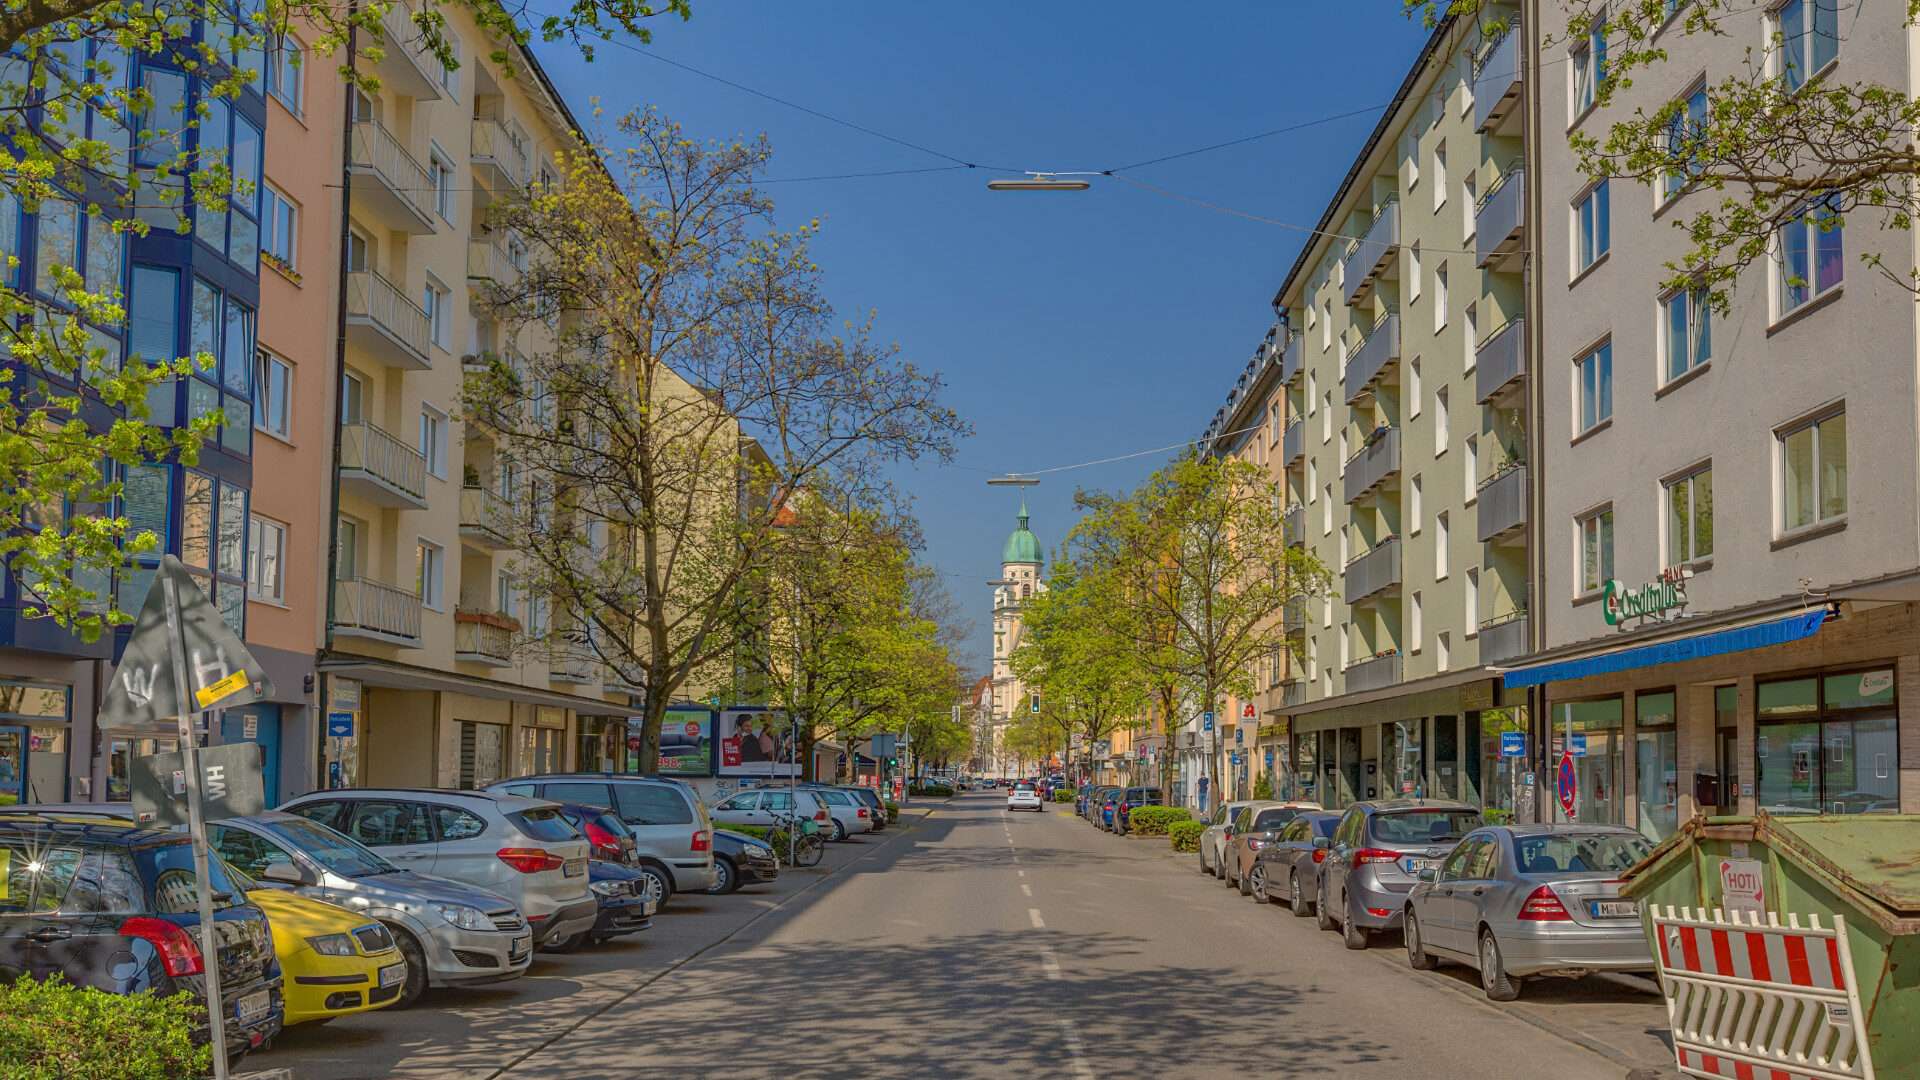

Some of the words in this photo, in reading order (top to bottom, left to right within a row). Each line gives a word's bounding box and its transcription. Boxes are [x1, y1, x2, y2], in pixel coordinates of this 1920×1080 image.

[1664, 565, 1684, 583] BANK
[1621, 578, 1682, 619] Creditplus
[206, 765, 226, 800] WH
[1728, 873, 1756, 889] HOTI
